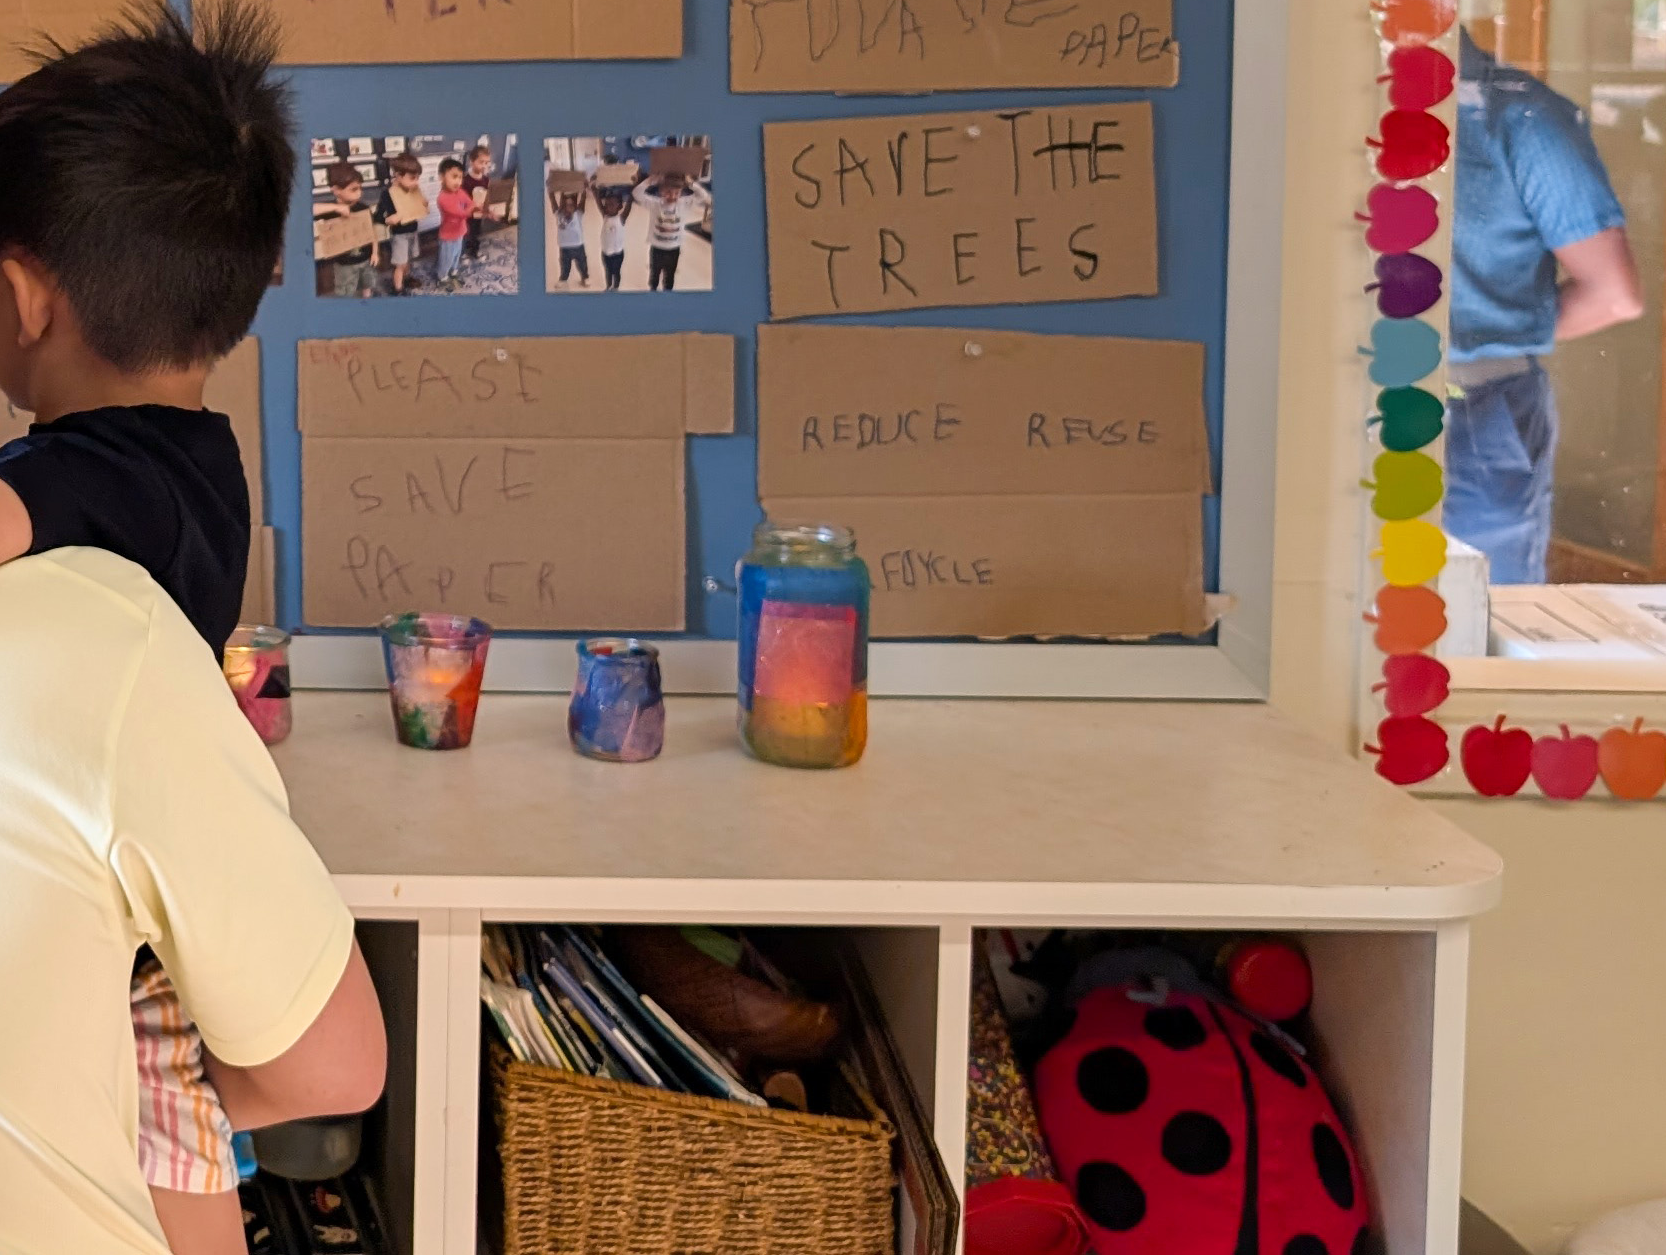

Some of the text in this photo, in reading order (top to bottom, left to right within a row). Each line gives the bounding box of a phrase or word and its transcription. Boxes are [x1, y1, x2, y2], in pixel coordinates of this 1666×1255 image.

[791, 111, 1127, 209] SAVE THE
[811, 218, 1099, 308] TREES
[346, 354, 543, 405] PLEASE
[802, 402, 962, 452] REDUCE
[1026, 412, 1161, 448] REUSE
[348, 445, 535, 515] SAVE
[341, 534, 556, 608] PAPER
